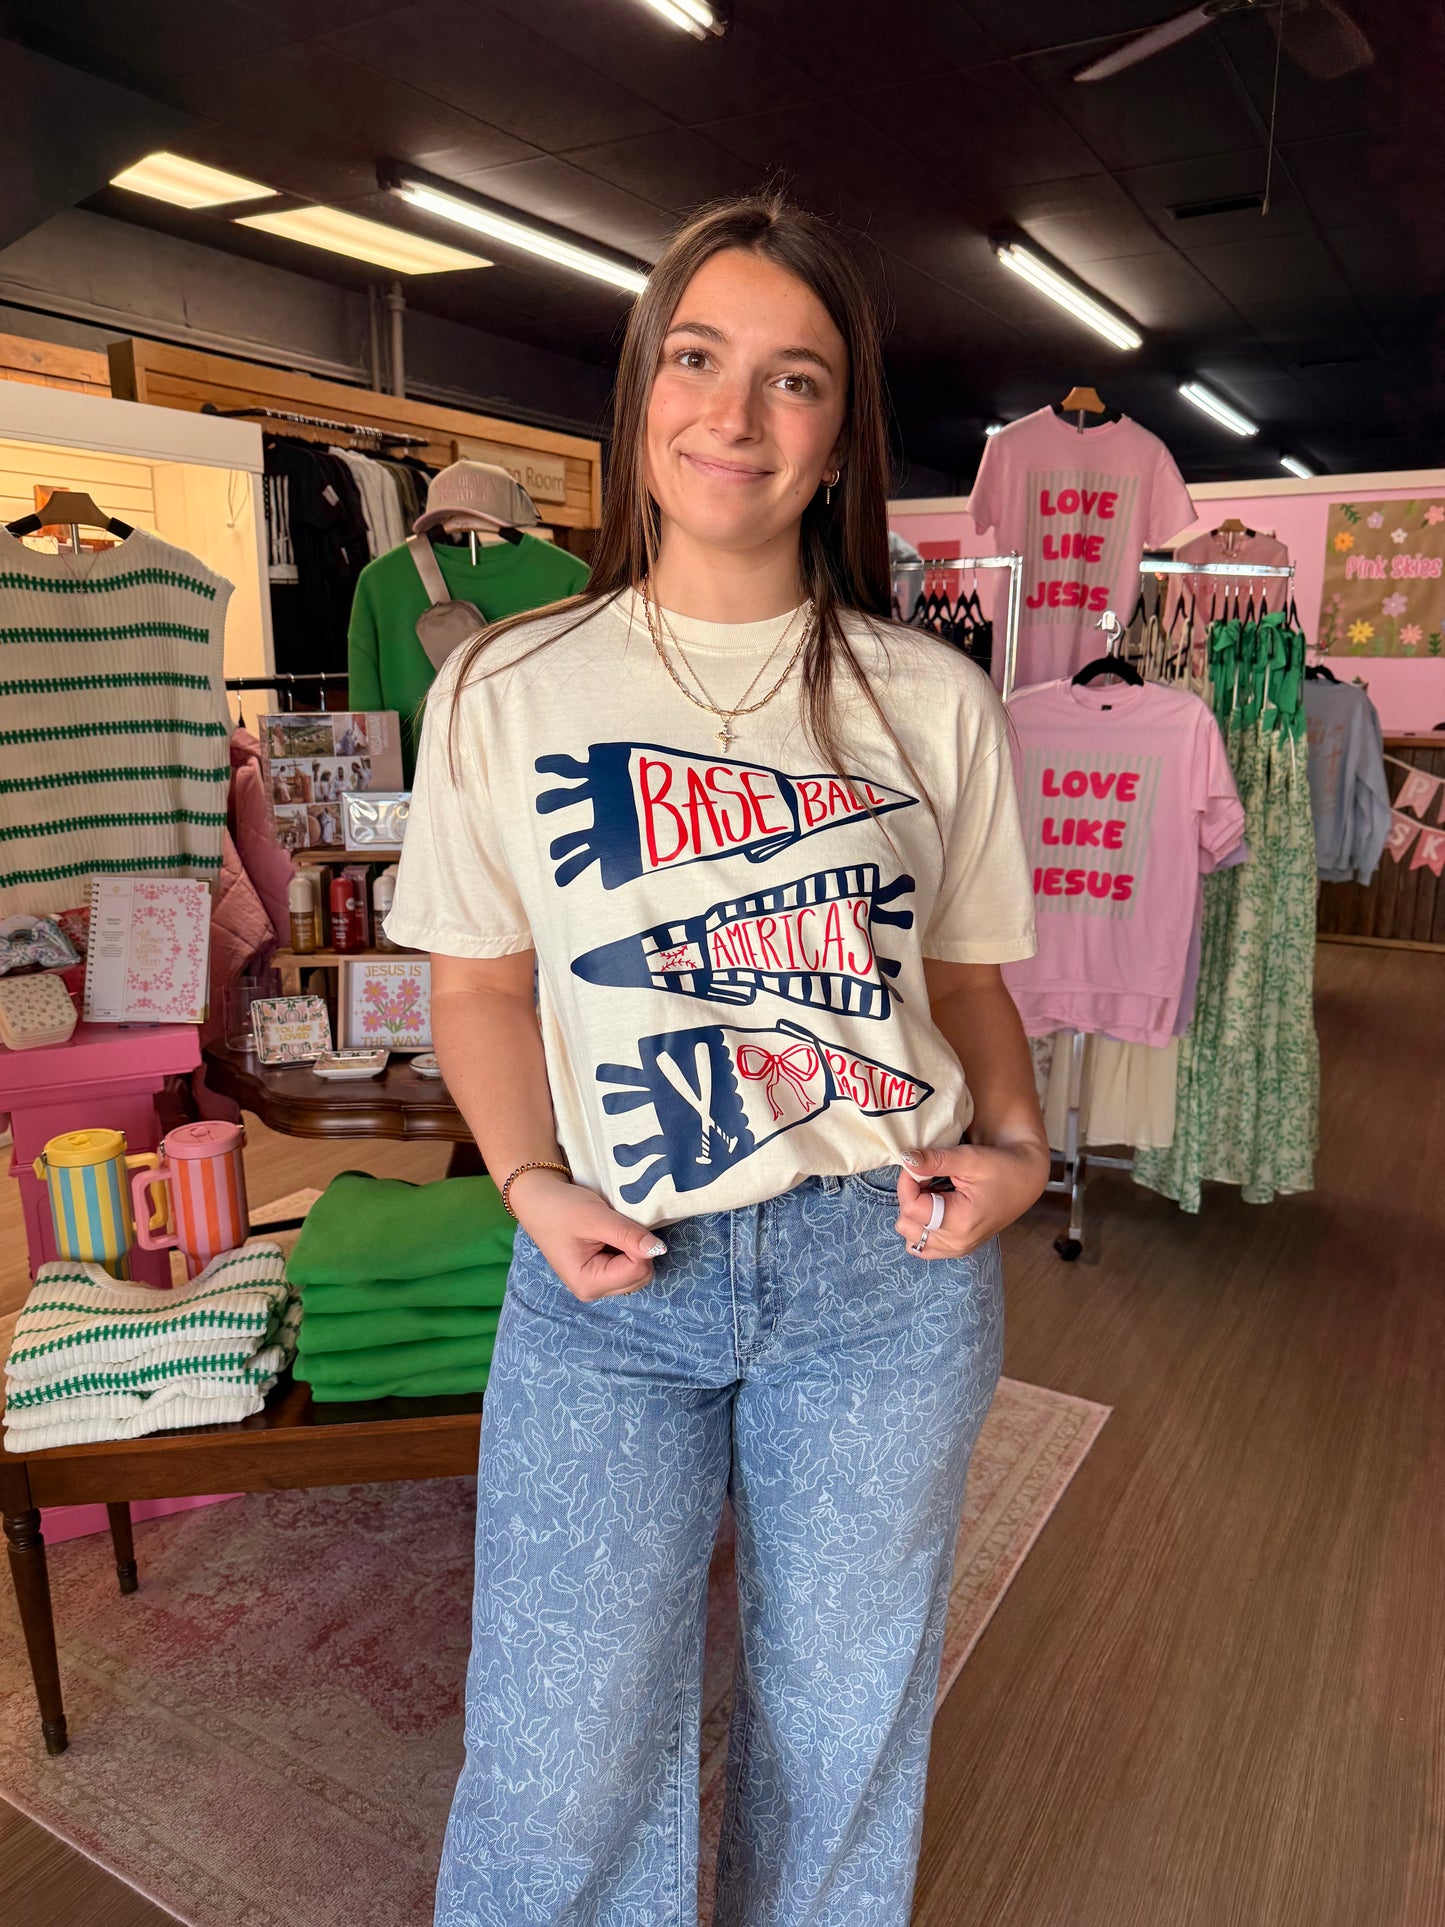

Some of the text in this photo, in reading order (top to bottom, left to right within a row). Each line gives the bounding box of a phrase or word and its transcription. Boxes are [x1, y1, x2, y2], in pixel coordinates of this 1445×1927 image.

[526, 466, 563, 491] Room
[1040, 488, 1119, 519] LOVE
[1042, 533, 1105, 563] LIKE
[1346, 553, 1443, 580] Pink Skies
[1042, 768, 1140, 802] LOVE
[639, 757, 787, 867] BASE
[1041, 817, 1126, 849] LIKE
[713, 900, 873, 976] AMERICA'S
[364, 964, 422, 977] JESUS IS
[274, 1025, 313, 1033] YOU ARE
[279, 1033, 310, 1041] LOVED
[361, 1036, 423, 1047] THE WAY
[825, 1048, 915, 1109] PASTIME
